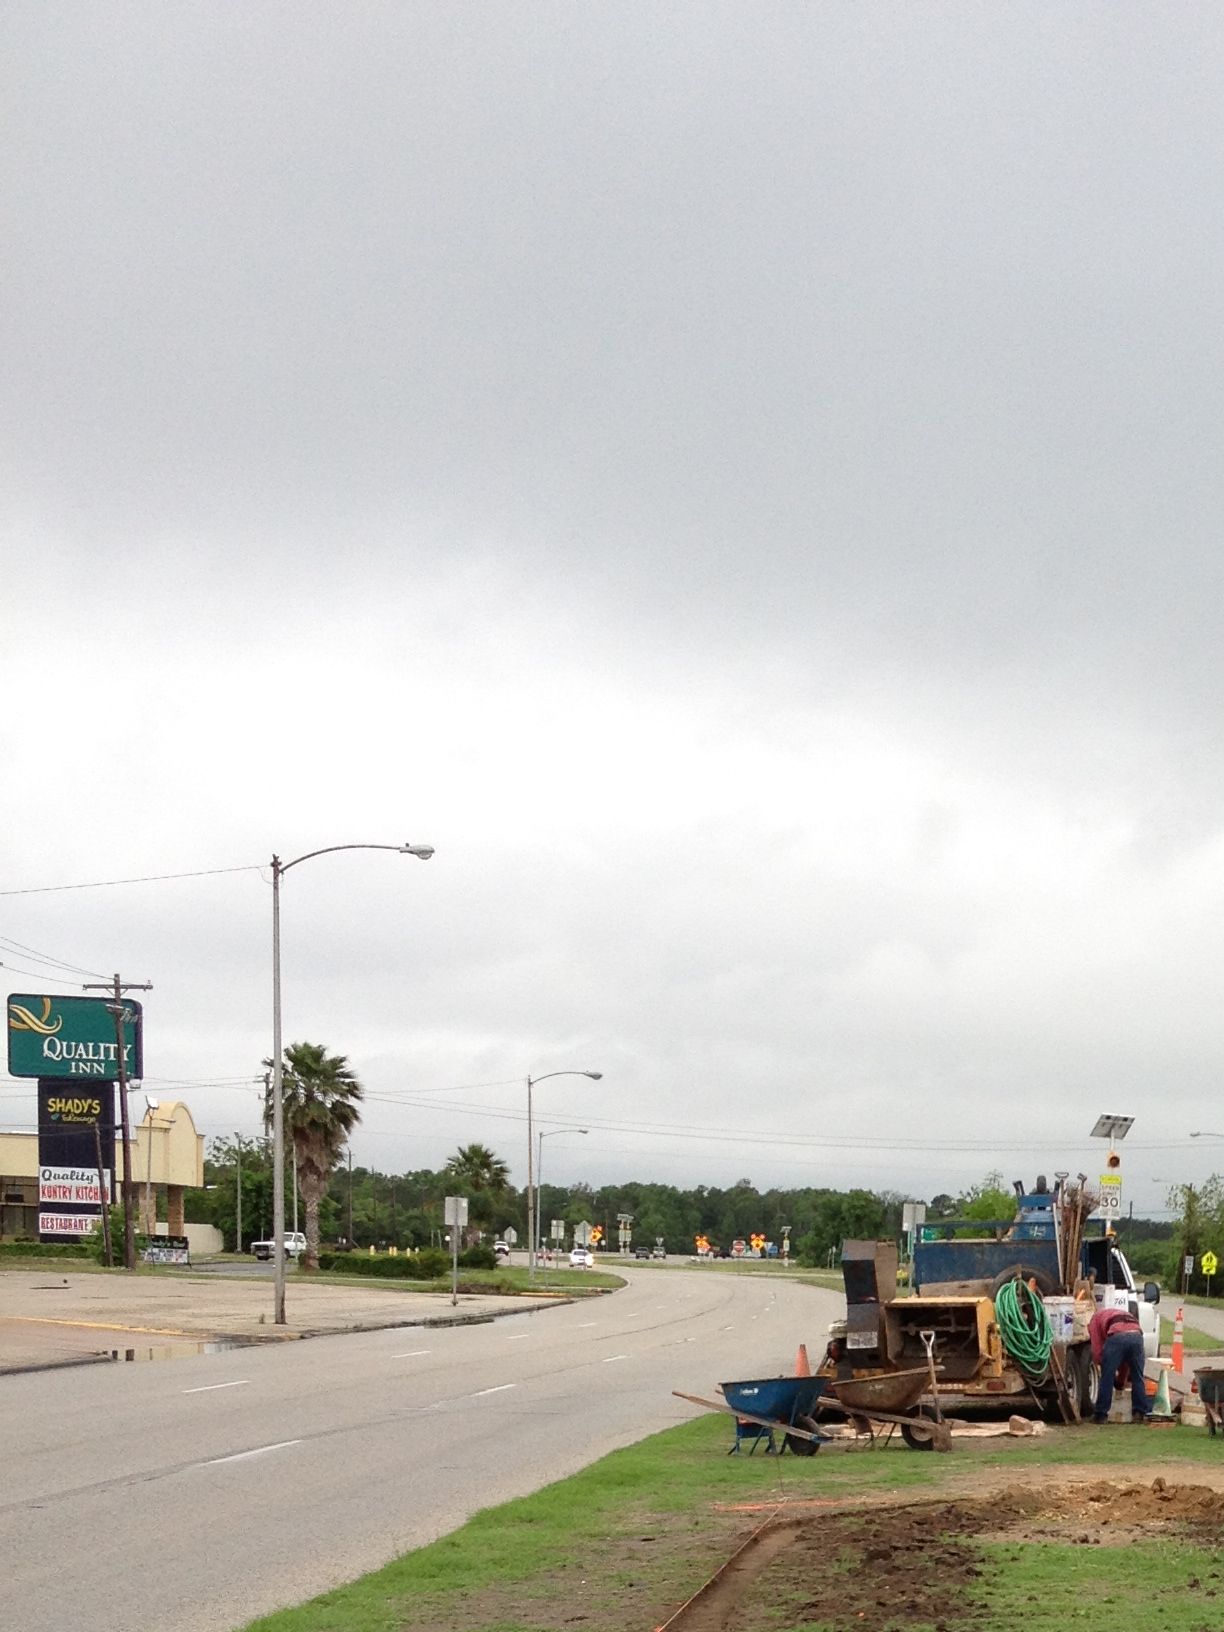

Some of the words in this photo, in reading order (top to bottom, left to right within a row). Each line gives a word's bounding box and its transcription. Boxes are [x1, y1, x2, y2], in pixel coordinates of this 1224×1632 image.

[70, 1062, 105, 1074] INN
[48, 1097, 100, 1114] SHADY'S
[42, 1169, 94, 1184] Quality
[41, 1184, 72, 1200] KUNTRY
[75, 1185, 109, 1201] KITCHN
[1102, 1197, 1119, 1208] 30
[40, 1217, 88, 1231] RESTAURANT
